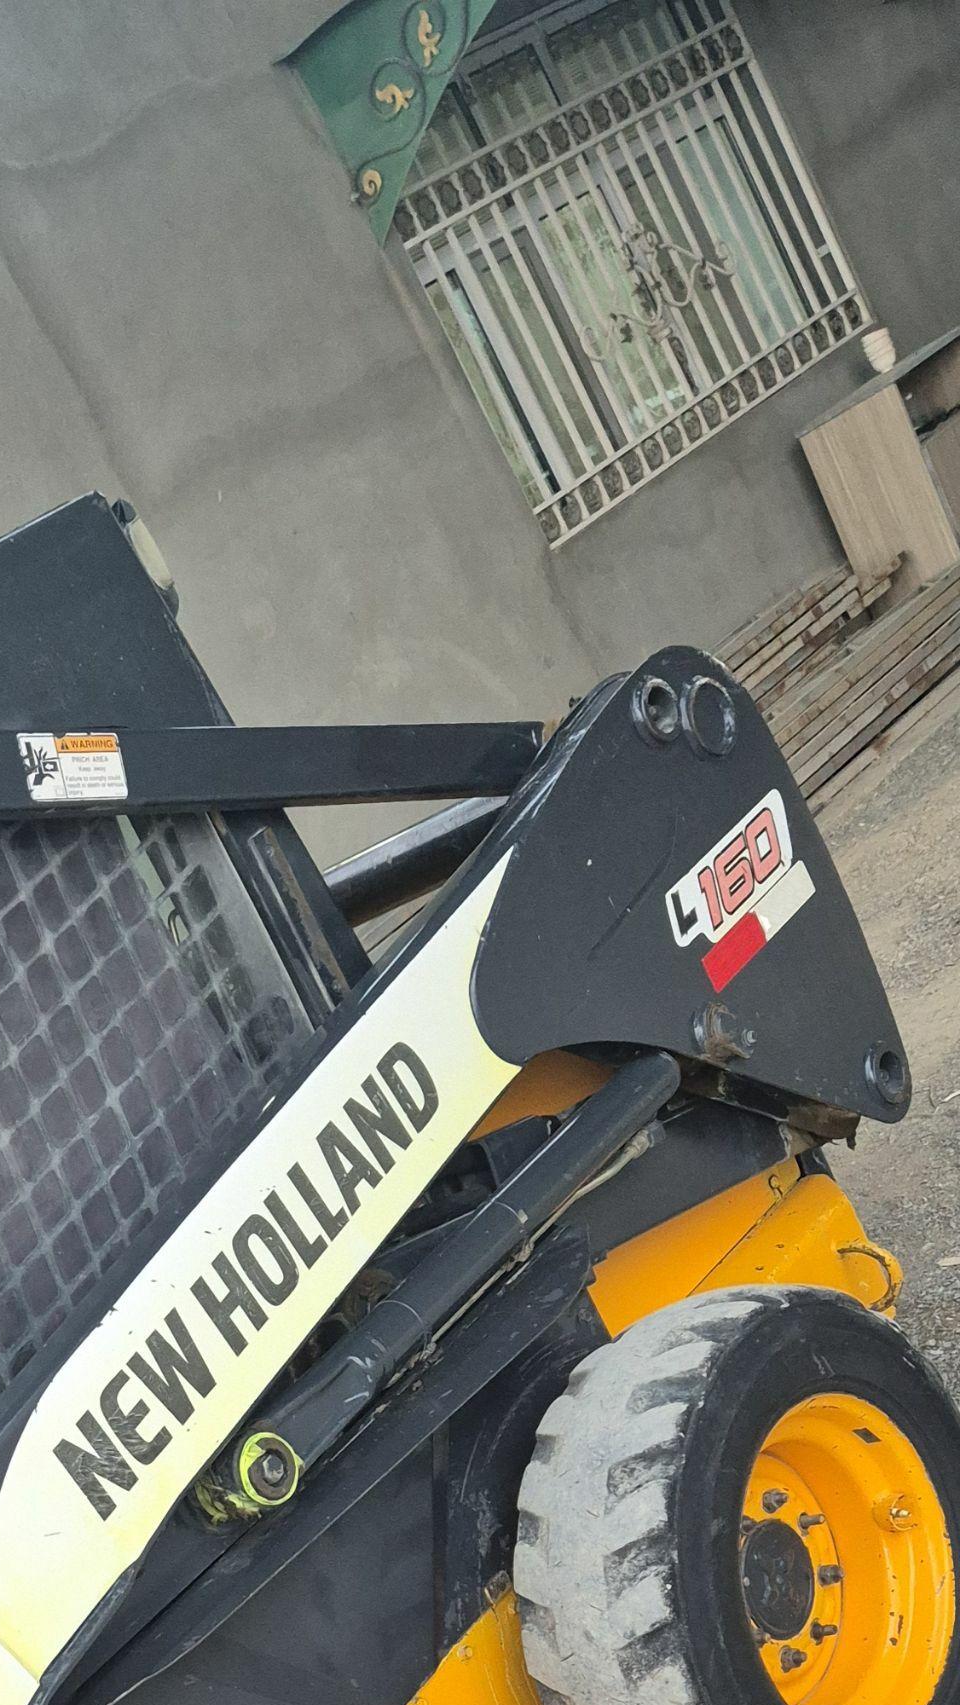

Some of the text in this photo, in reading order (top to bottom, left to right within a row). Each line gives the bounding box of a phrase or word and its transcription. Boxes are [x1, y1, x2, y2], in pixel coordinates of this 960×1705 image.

[70, 739, 114, 748] WARNING
[671, 807, 782, 937] L160
[52, 1041, 439, 1521] NEW HOLLAND
